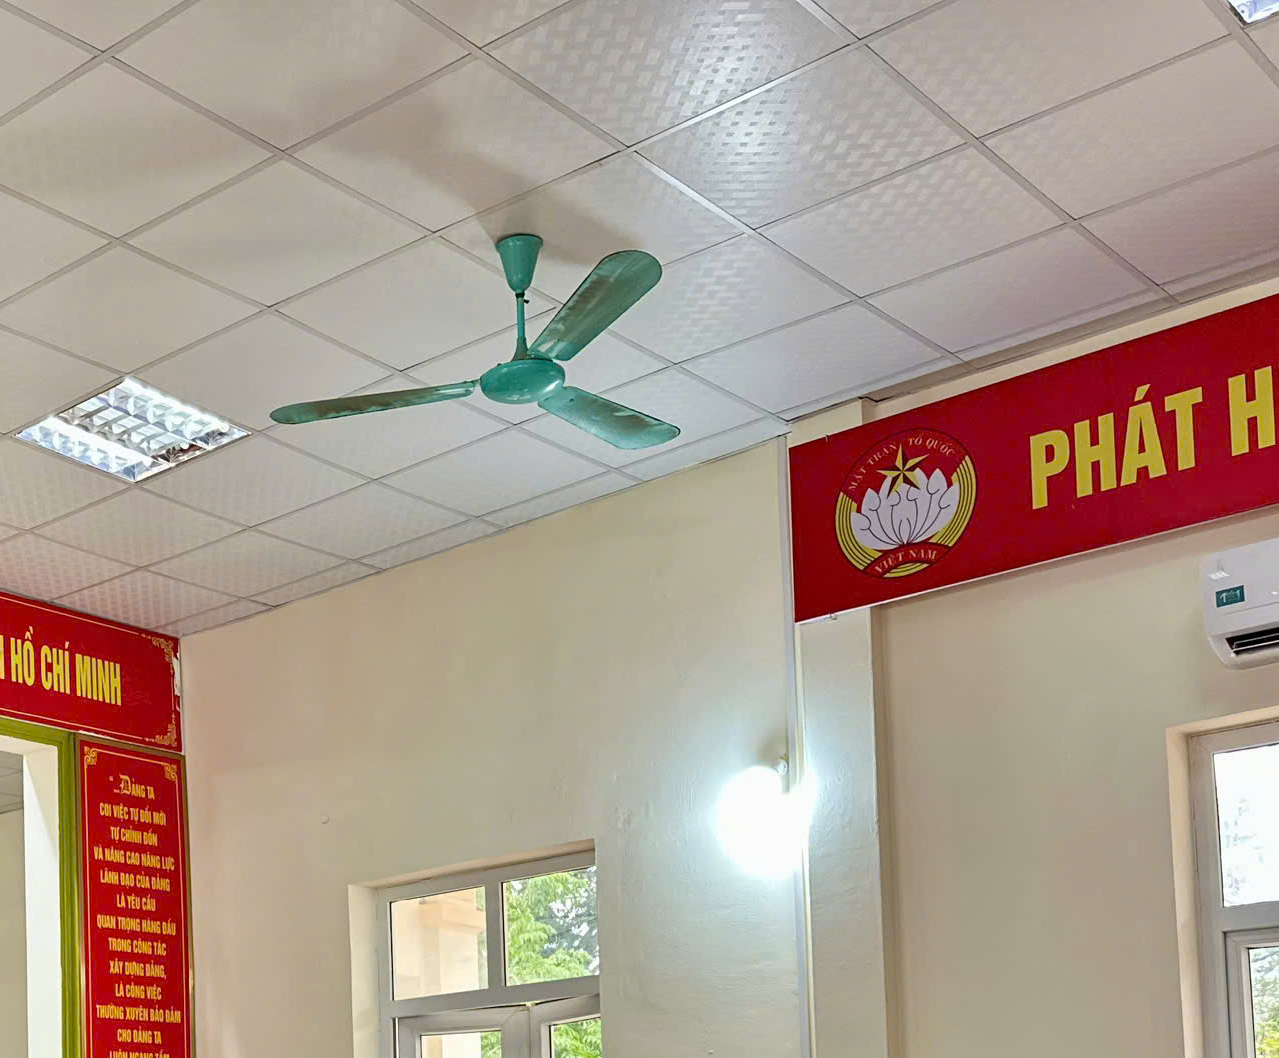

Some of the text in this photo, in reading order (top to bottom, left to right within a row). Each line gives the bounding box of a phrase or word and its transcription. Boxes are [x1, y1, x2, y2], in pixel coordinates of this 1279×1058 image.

[1030, 384, 1203, 510] PHÁT
[909, 549, 938, 560] NAM
[10, 625, 35, 687] HỒ
[41, 641, 70, 696] CHÍ
[76, 653, 122, 706] MINH
[126, 851, 140, 866] CAO
[96, 914, 116, 929] QUAN
[117, 1028, 131, 1043] CHO
